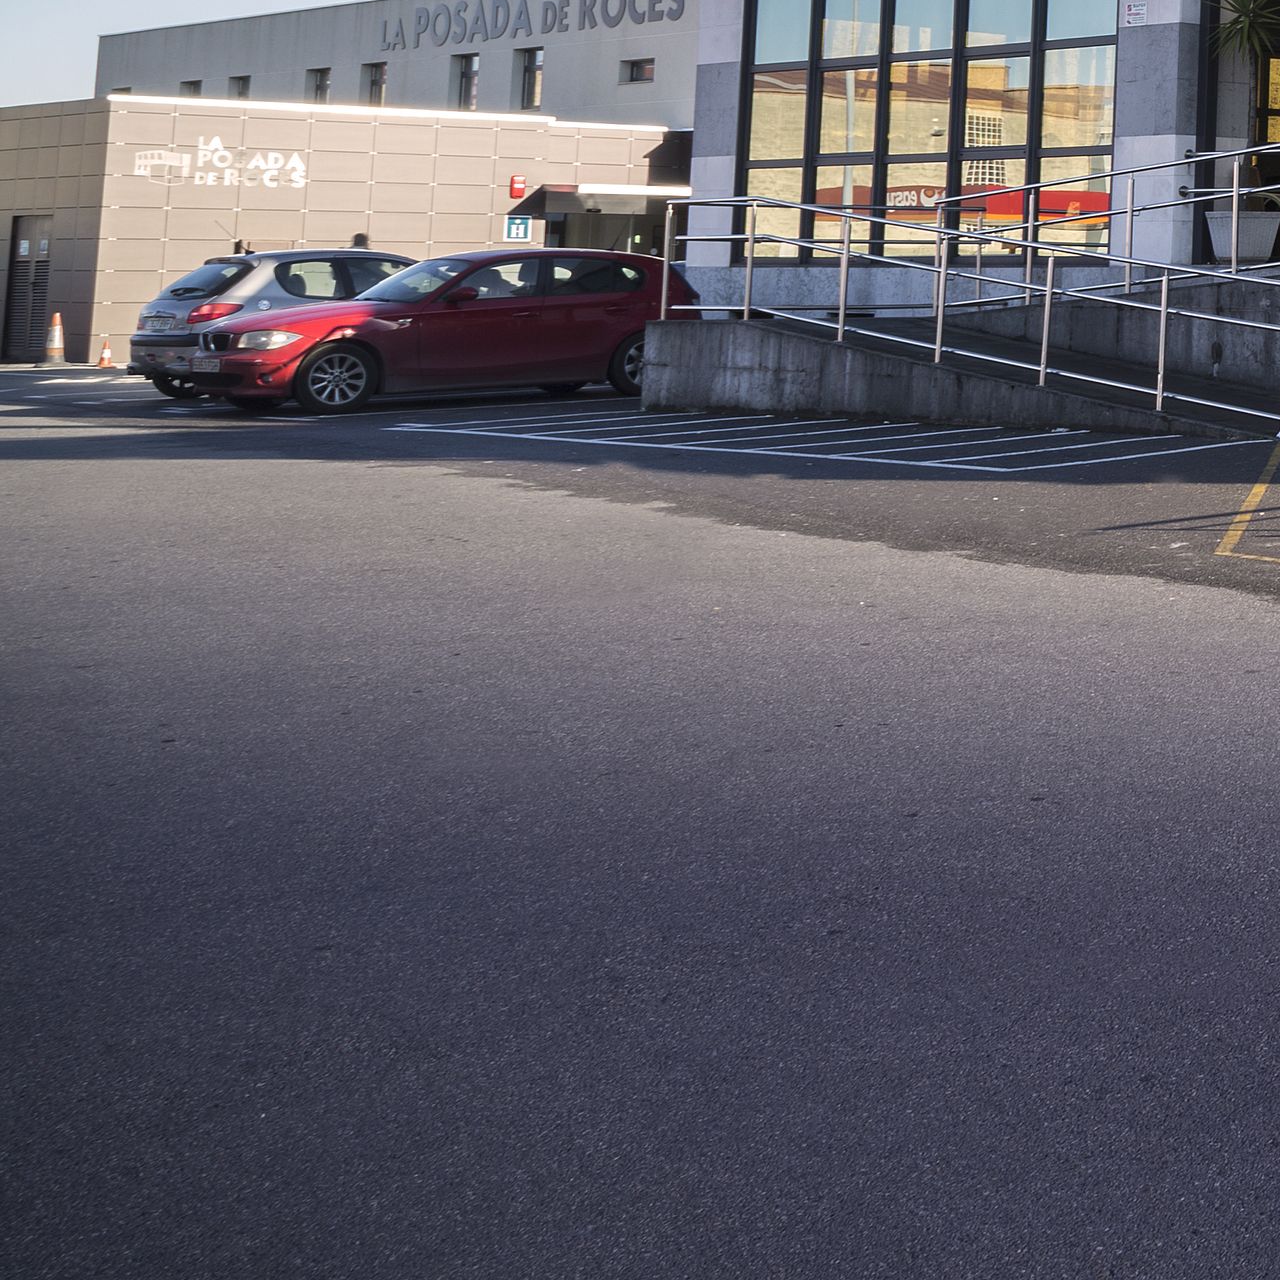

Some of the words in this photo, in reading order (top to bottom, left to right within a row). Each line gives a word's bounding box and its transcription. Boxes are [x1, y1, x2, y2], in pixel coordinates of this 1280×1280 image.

[379, 18, 406, 52] LA
[540, 0, 570, 35] DE
[197, 135, 225, 151] LA
[196, 150, 306, 170] POSADA
[194, 171, 219, 186] DE
[510, 224, 525, 238] H
